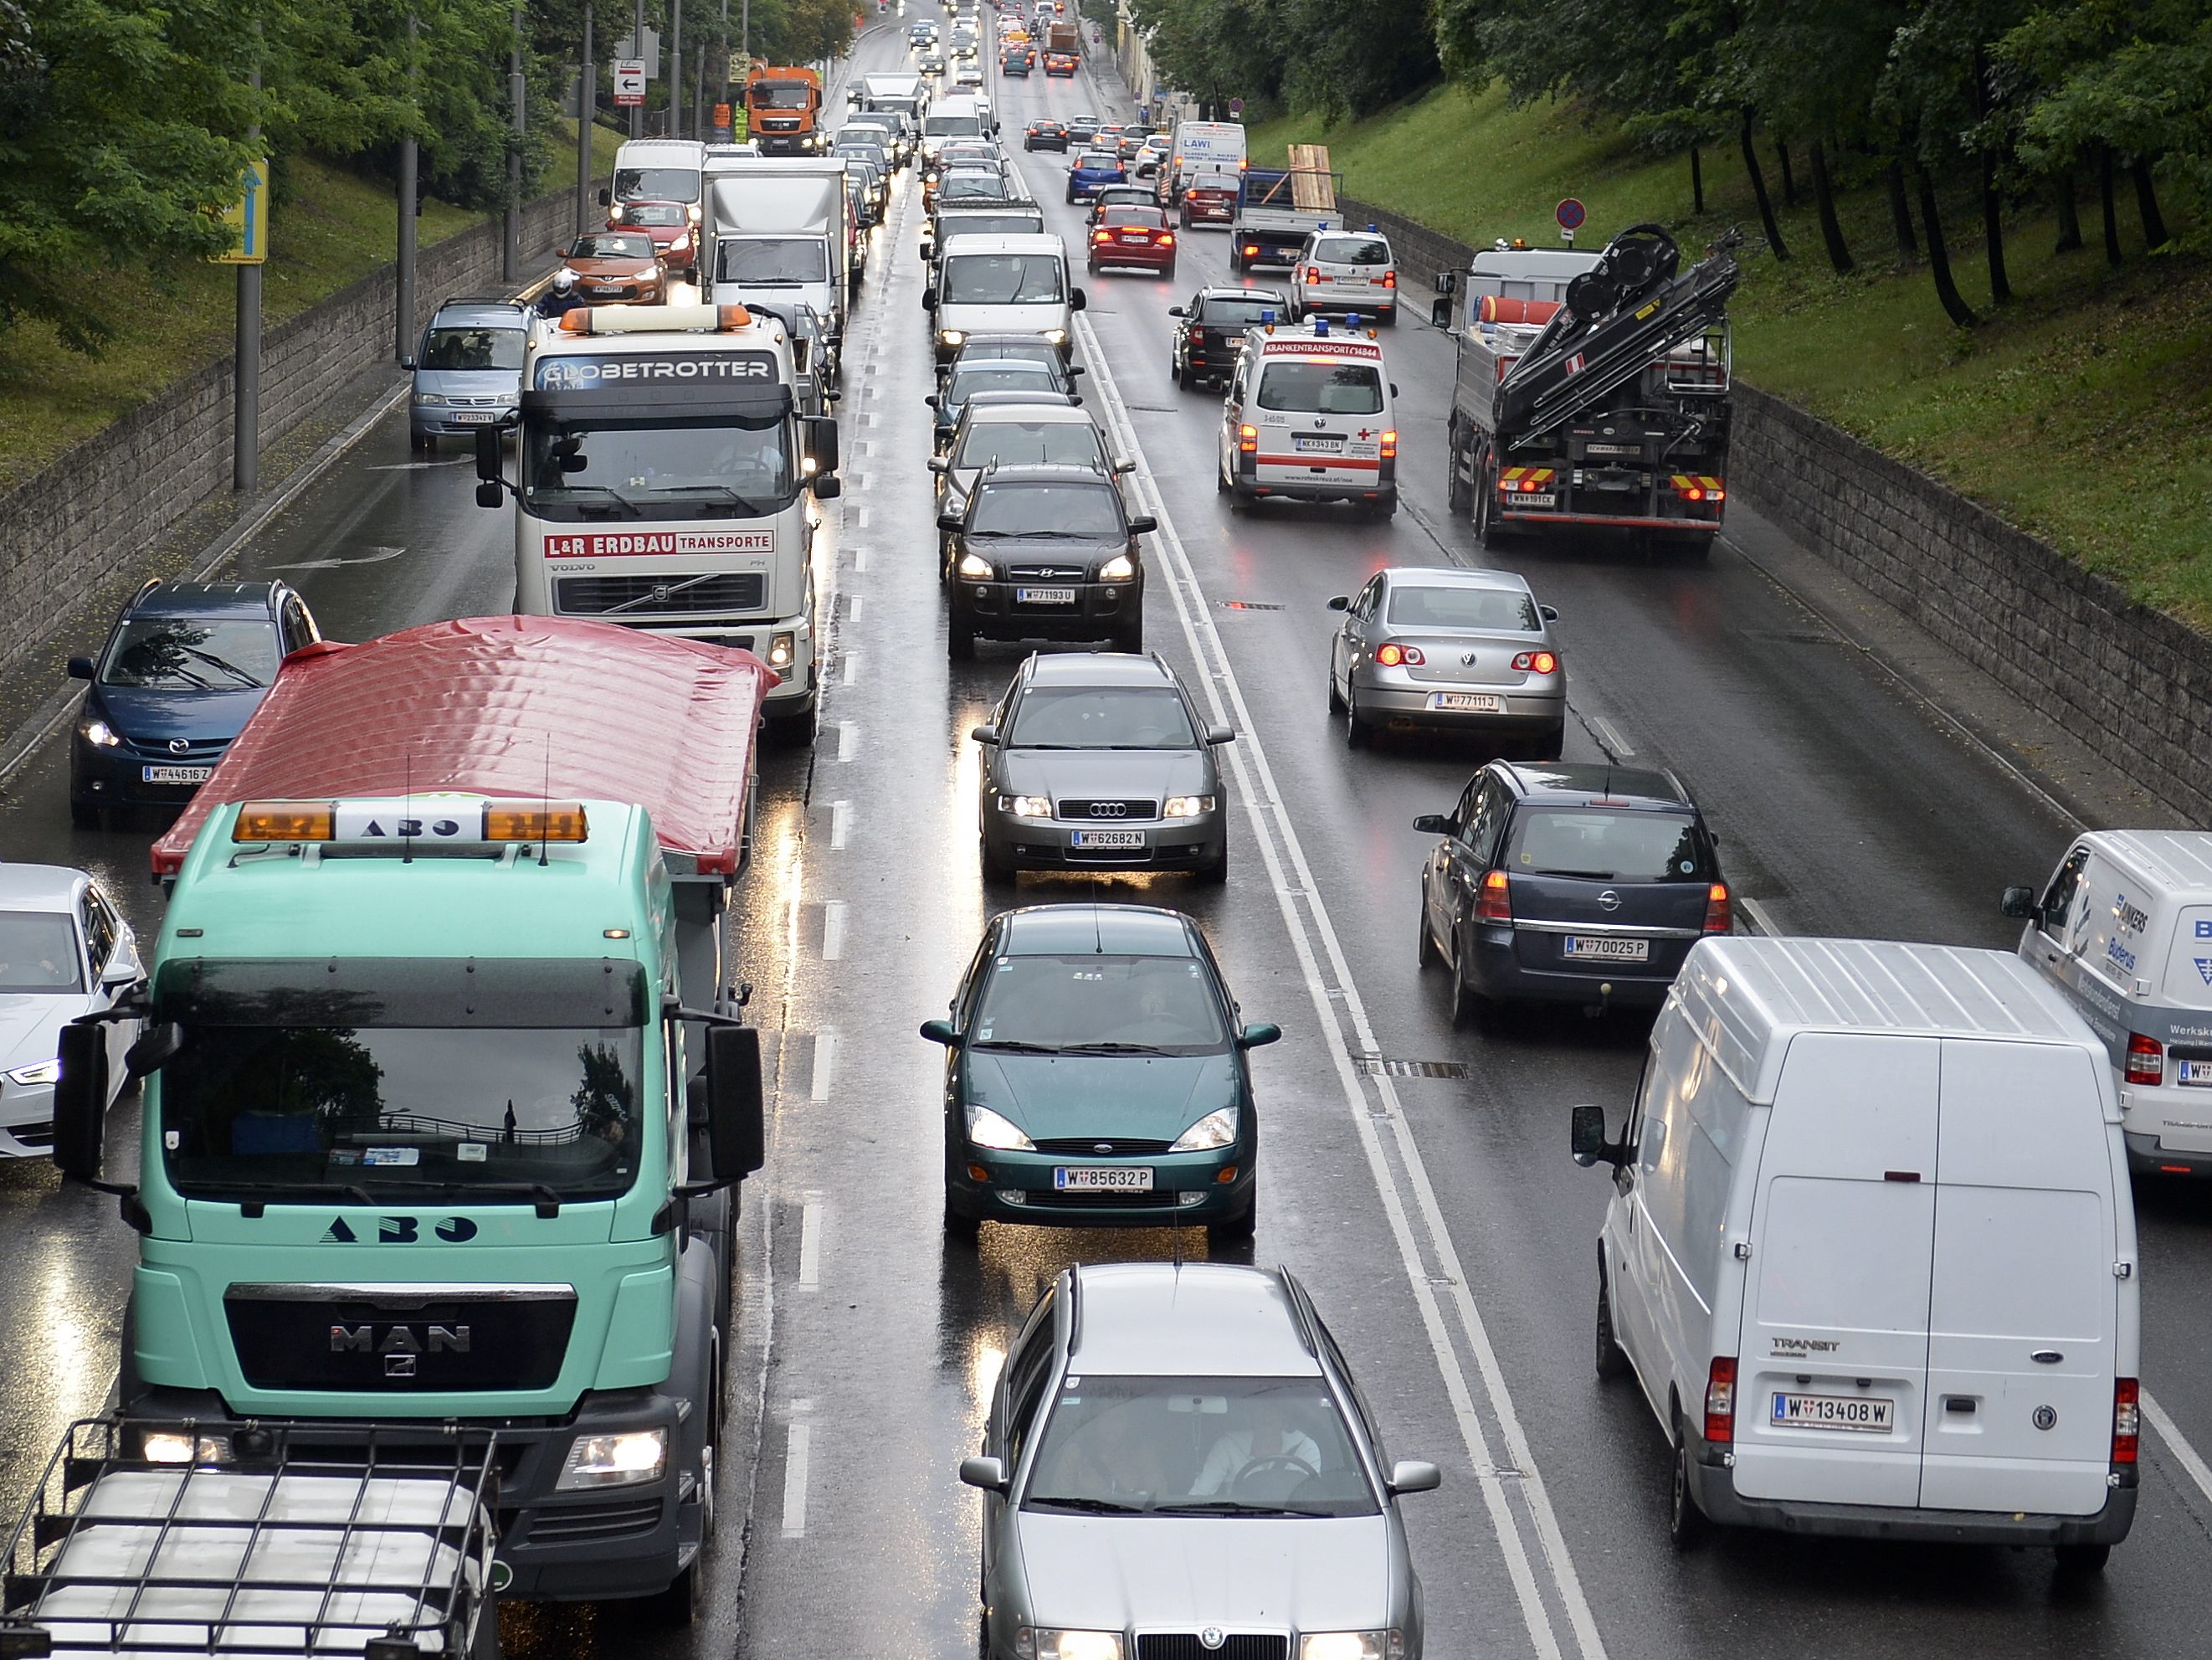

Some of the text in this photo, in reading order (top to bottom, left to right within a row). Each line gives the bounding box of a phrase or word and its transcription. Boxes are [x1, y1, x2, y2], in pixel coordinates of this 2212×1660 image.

[1183, 139, 1211, 148] LAWI
[1266, 344, 1349, 354] KRANKENTRANSPORT
[544, 361, 768, 382] GLOBETROTTER
[549, 535, 769, 555] L&R ERDBAU TRANSPORTE
[168, 769, 199, 779] 44616
[360, 820, 459, 837] ABO
[1098, 833, 1132, 844] 62682
[2114, 895, 2149, 933] UNKERS
[1576, 939, 1585, 952] W
[1594, 940, 1634, 954] 70025
[2107, 937, 2137, 970] Buderus
[2190, 1065, 2201, 1078] W
[1067, 1171, 1078, 1185] W
[1090, 1171, 1136, 1185] 85632
[319, 1215, 478, 1243] ABO
[331, 1326, 470, 1353] MAN
[1772, 1338, 1840, 1352] TRANSIT
[1789, 1399, 1802, 1417] W
[1816, 1400, 1870, 1421] 13408
